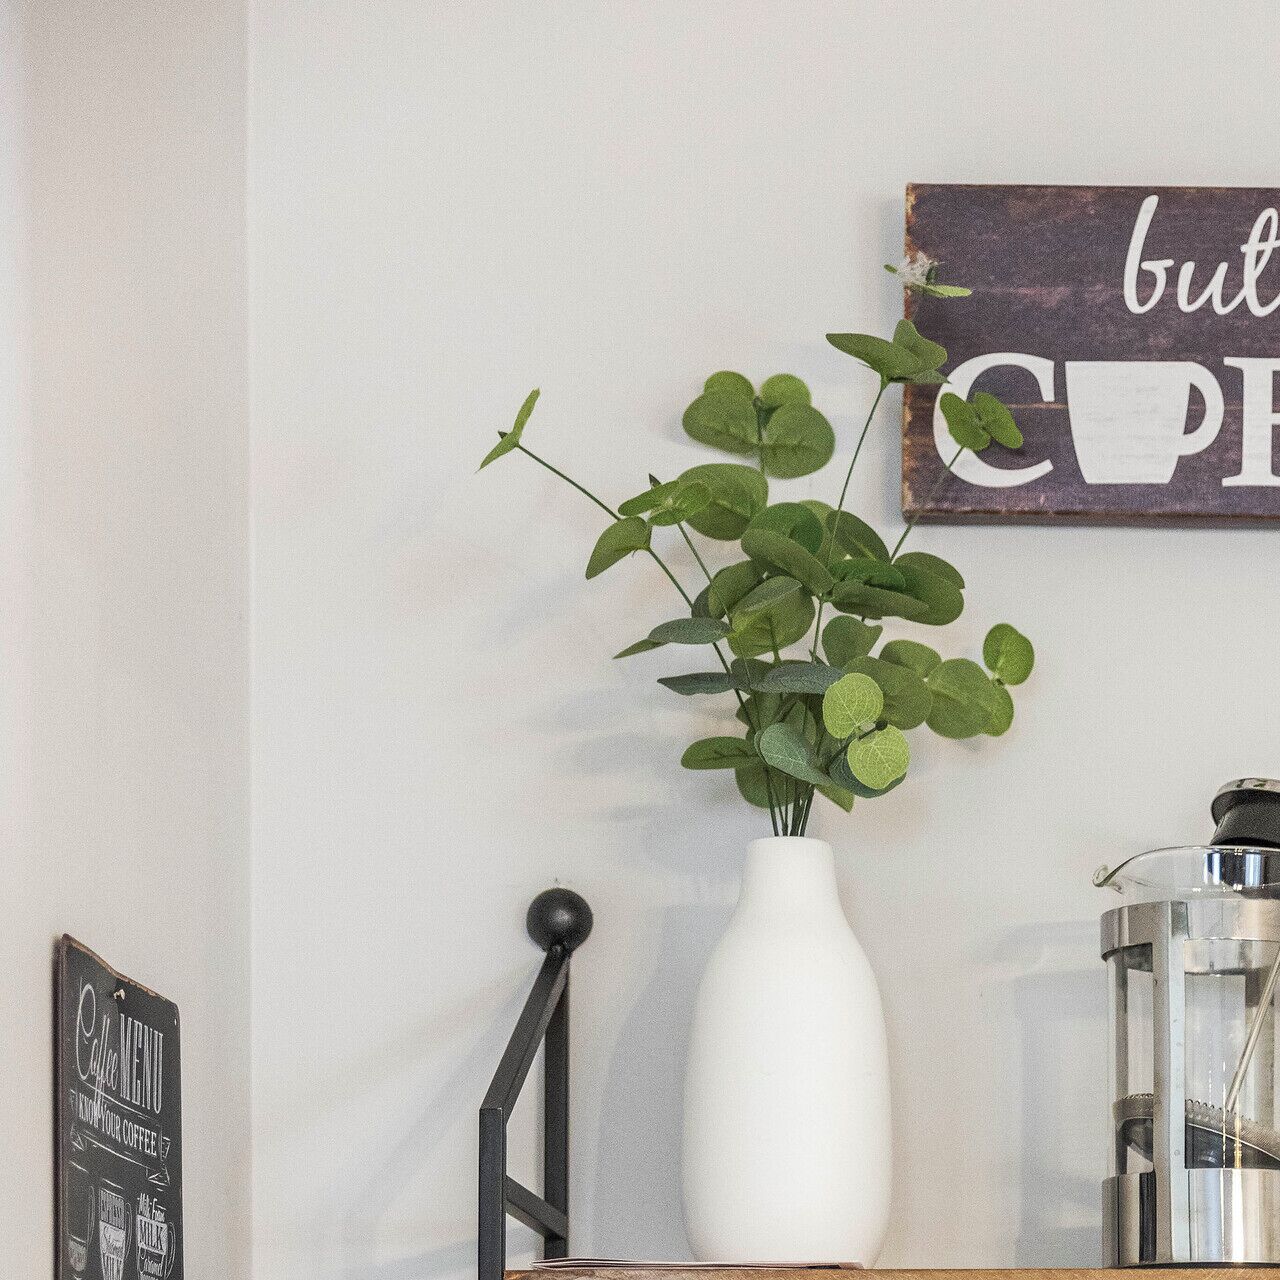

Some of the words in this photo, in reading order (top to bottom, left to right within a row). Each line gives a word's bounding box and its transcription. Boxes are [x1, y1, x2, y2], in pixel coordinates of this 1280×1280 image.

[76, 977, 119, 1117] Coffee
[119, 1012, 163, 1115] MENU
[122, 1118, 157, 1157] COFFEE
